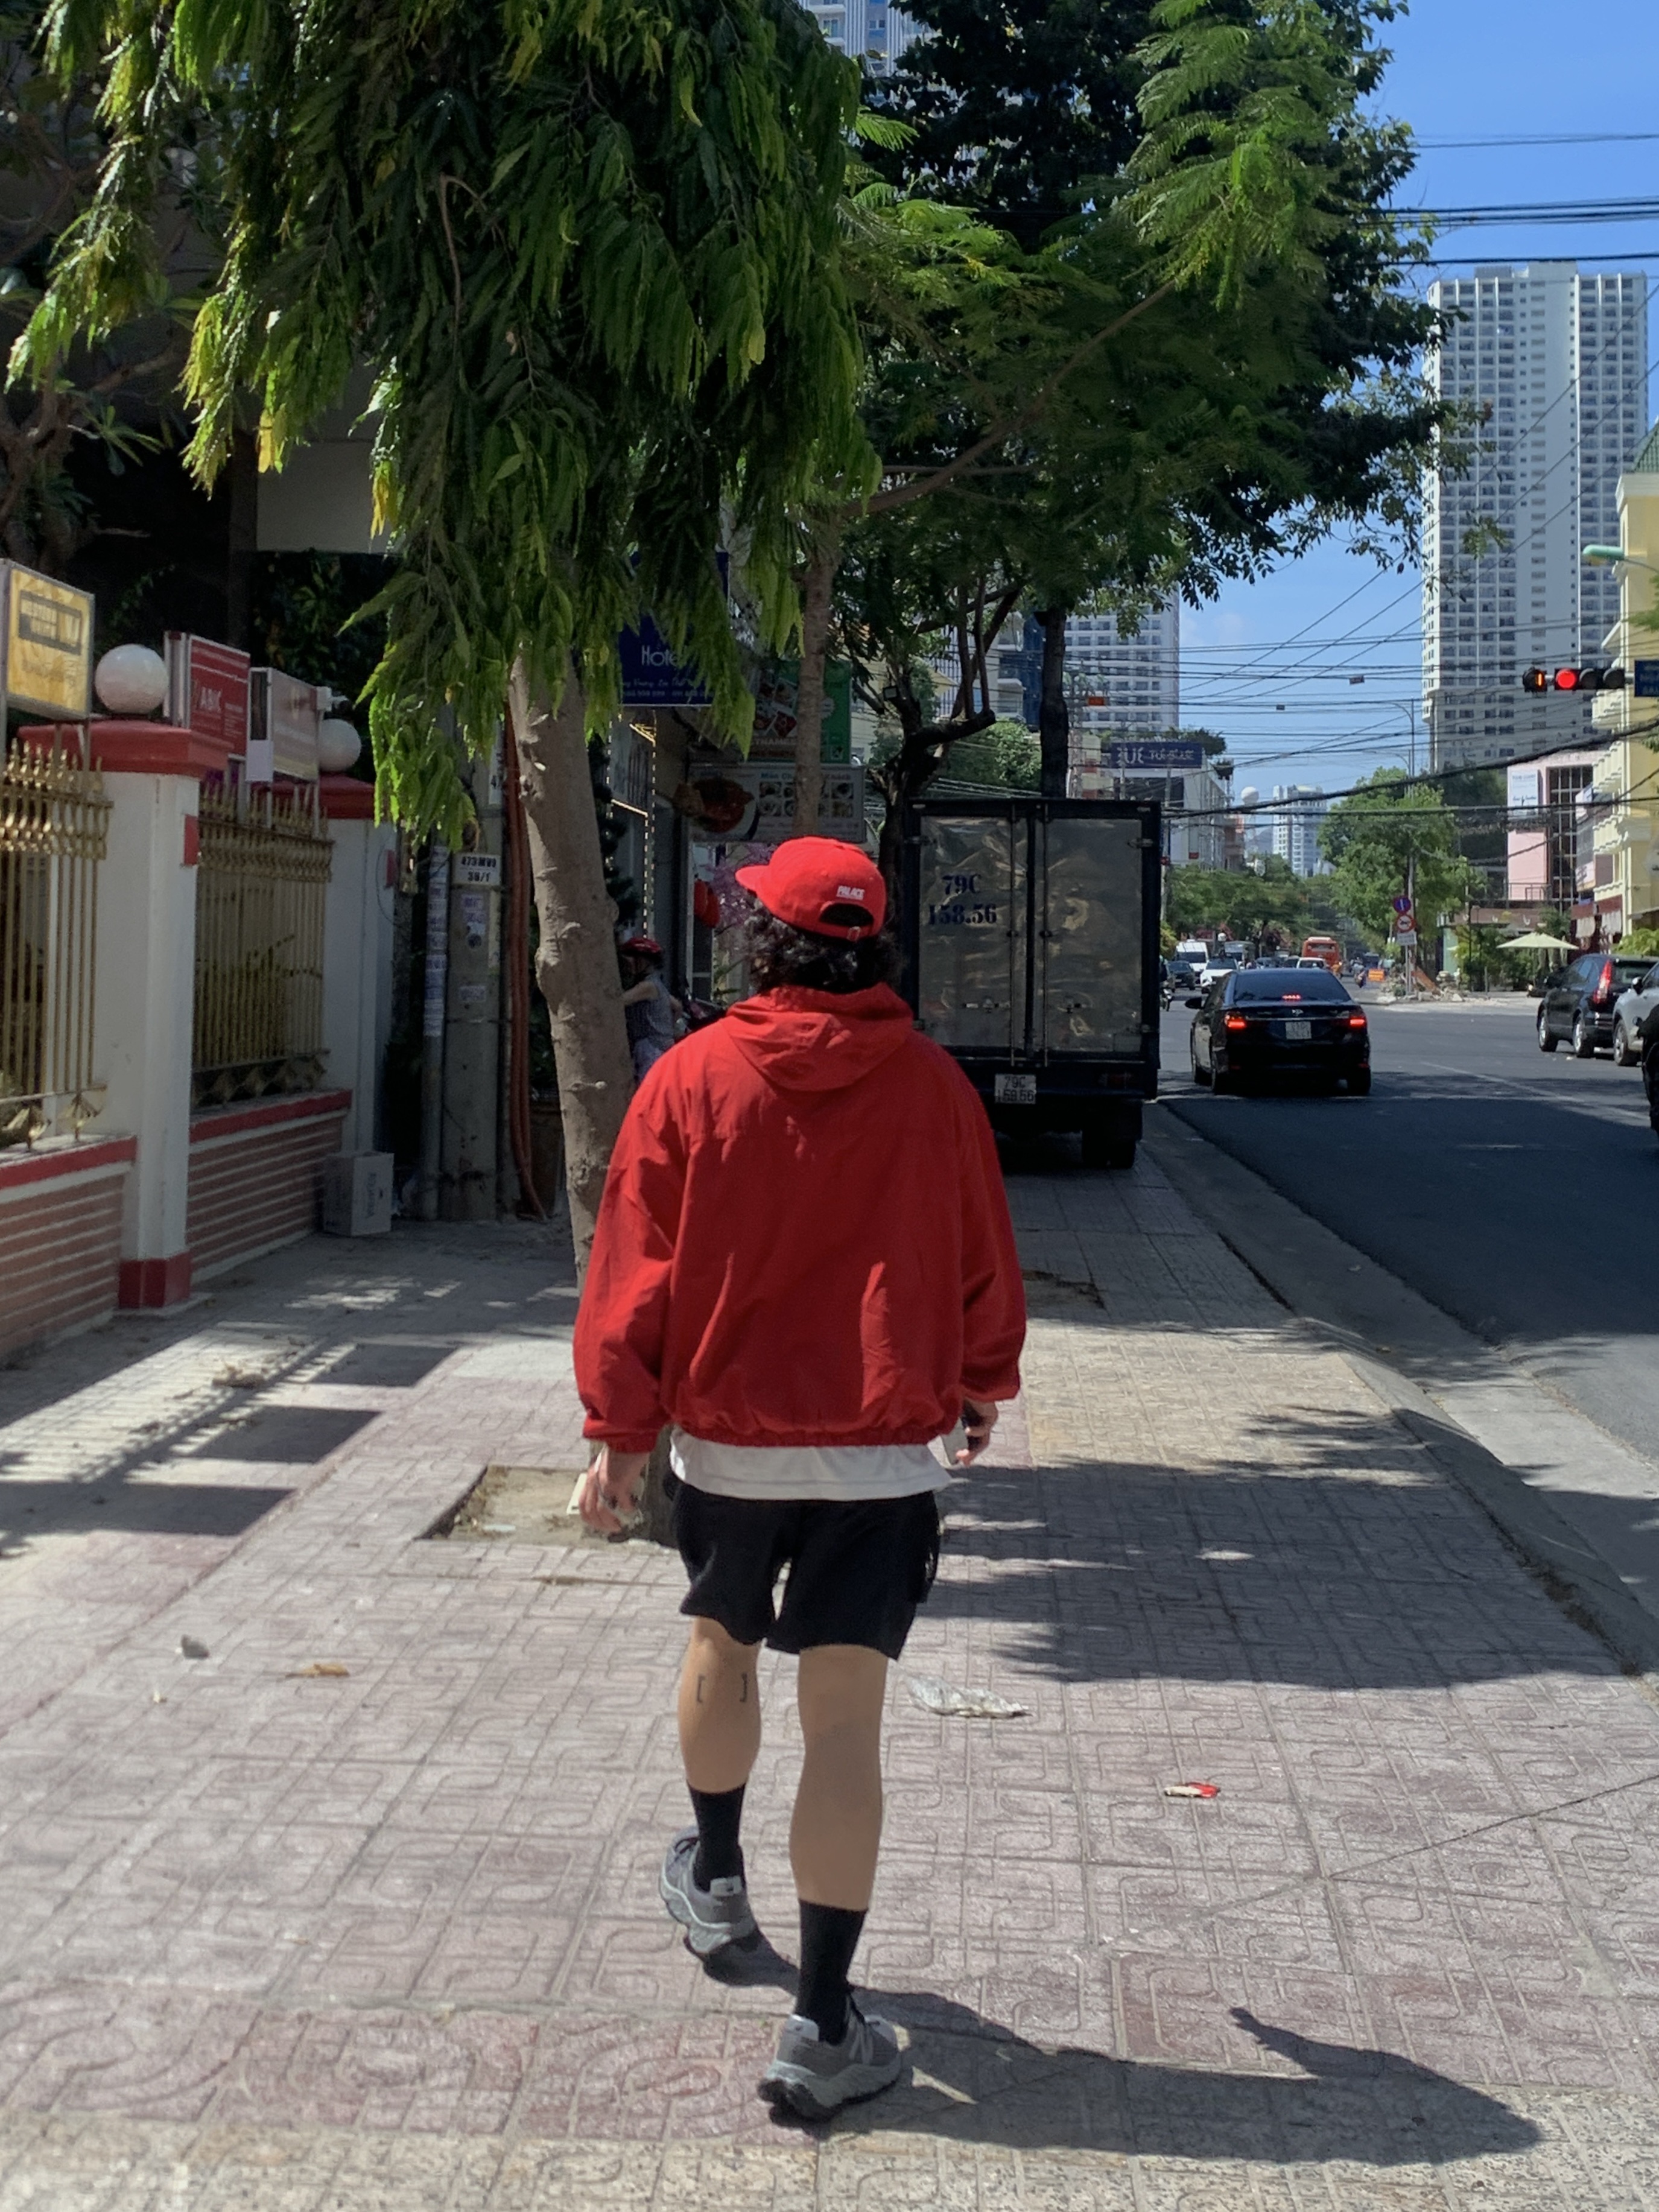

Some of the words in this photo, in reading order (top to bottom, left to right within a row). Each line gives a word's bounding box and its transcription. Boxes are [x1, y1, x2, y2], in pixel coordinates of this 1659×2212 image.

[641, 645, 677, 667] Hote
[942, 873, 982, 895] 79C
[929, 904, 997, 925] 158.56
[1004, 1076, 1026, 1088] 79C
